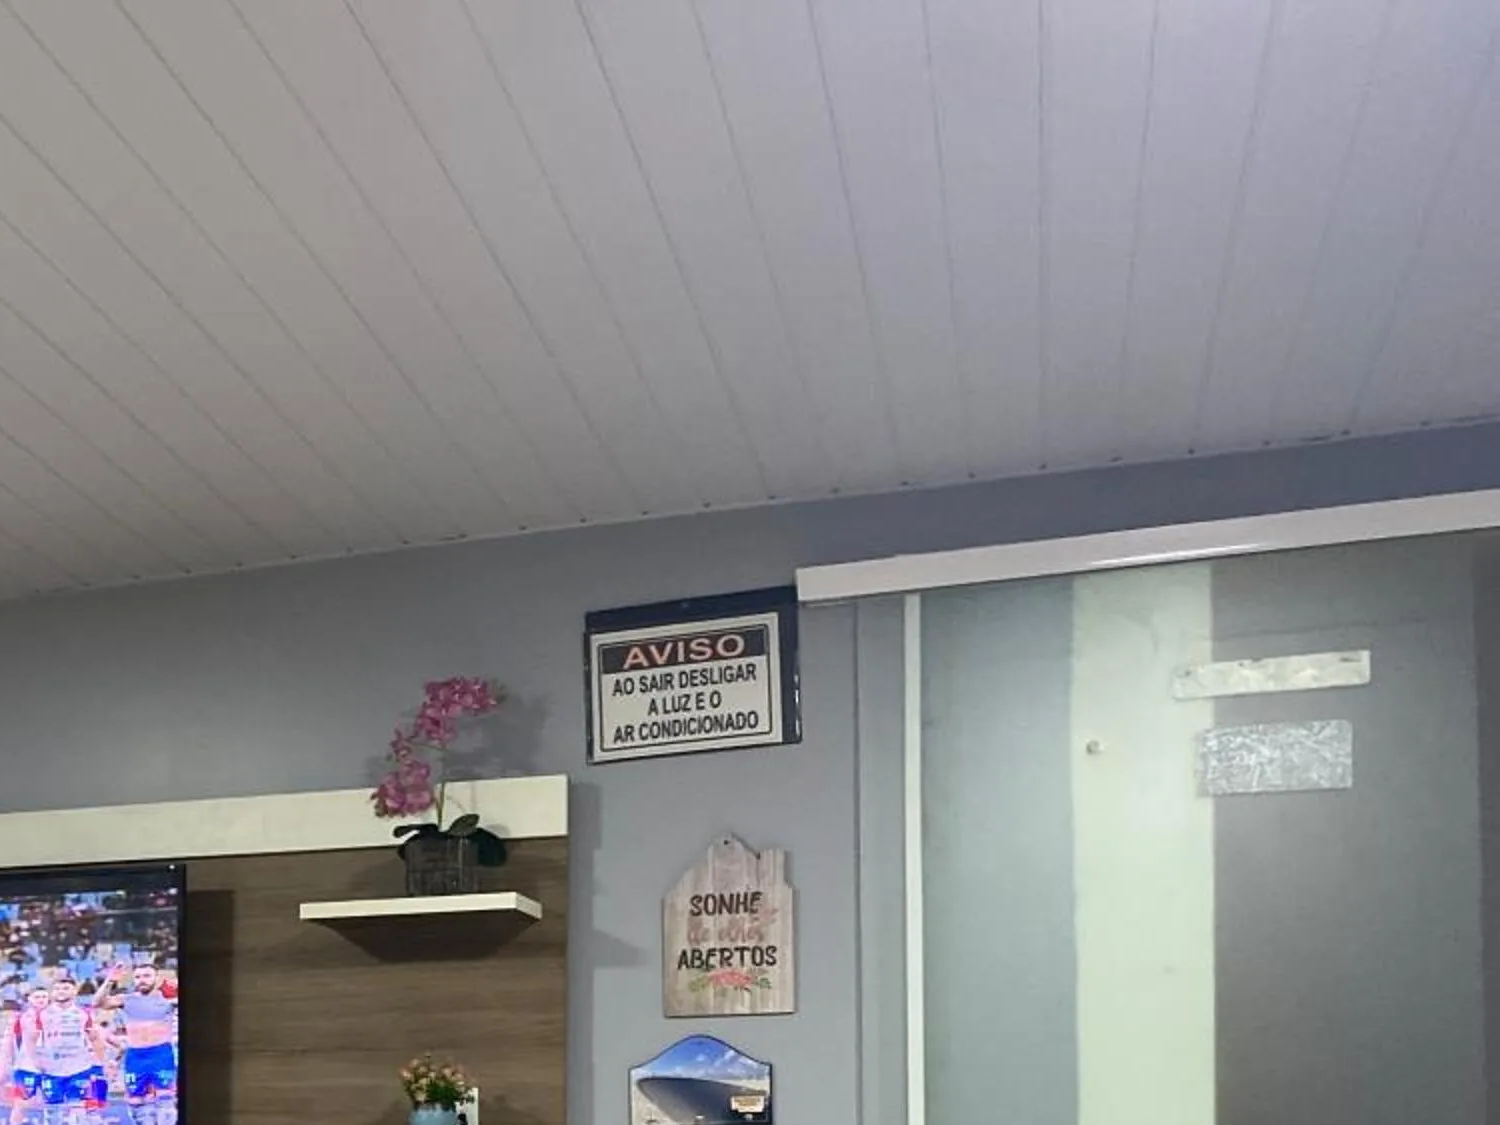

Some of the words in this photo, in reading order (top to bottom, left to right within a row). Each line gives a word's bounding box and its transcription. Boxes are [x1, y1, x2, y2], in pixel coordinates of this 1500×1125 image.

[623, 634, 745, 669] AVISO
[612, 677, 635, 697] AO
[639, 673, 675, 693] SAIR
[679, 663, 757, 689] DESLIGAR
[648, 698, 660, 716] A
[662, 694, 691, 715] LUZ
[695, 692, 706, 711] E
[709, 690, 722, 709] O
[613, 725, 635, 744] AR
[638, 710, 759, 741] CONDICIONADO
[690, 891, 763, 917] SONHE
[677, 945, 778, 971] ABERTOS
